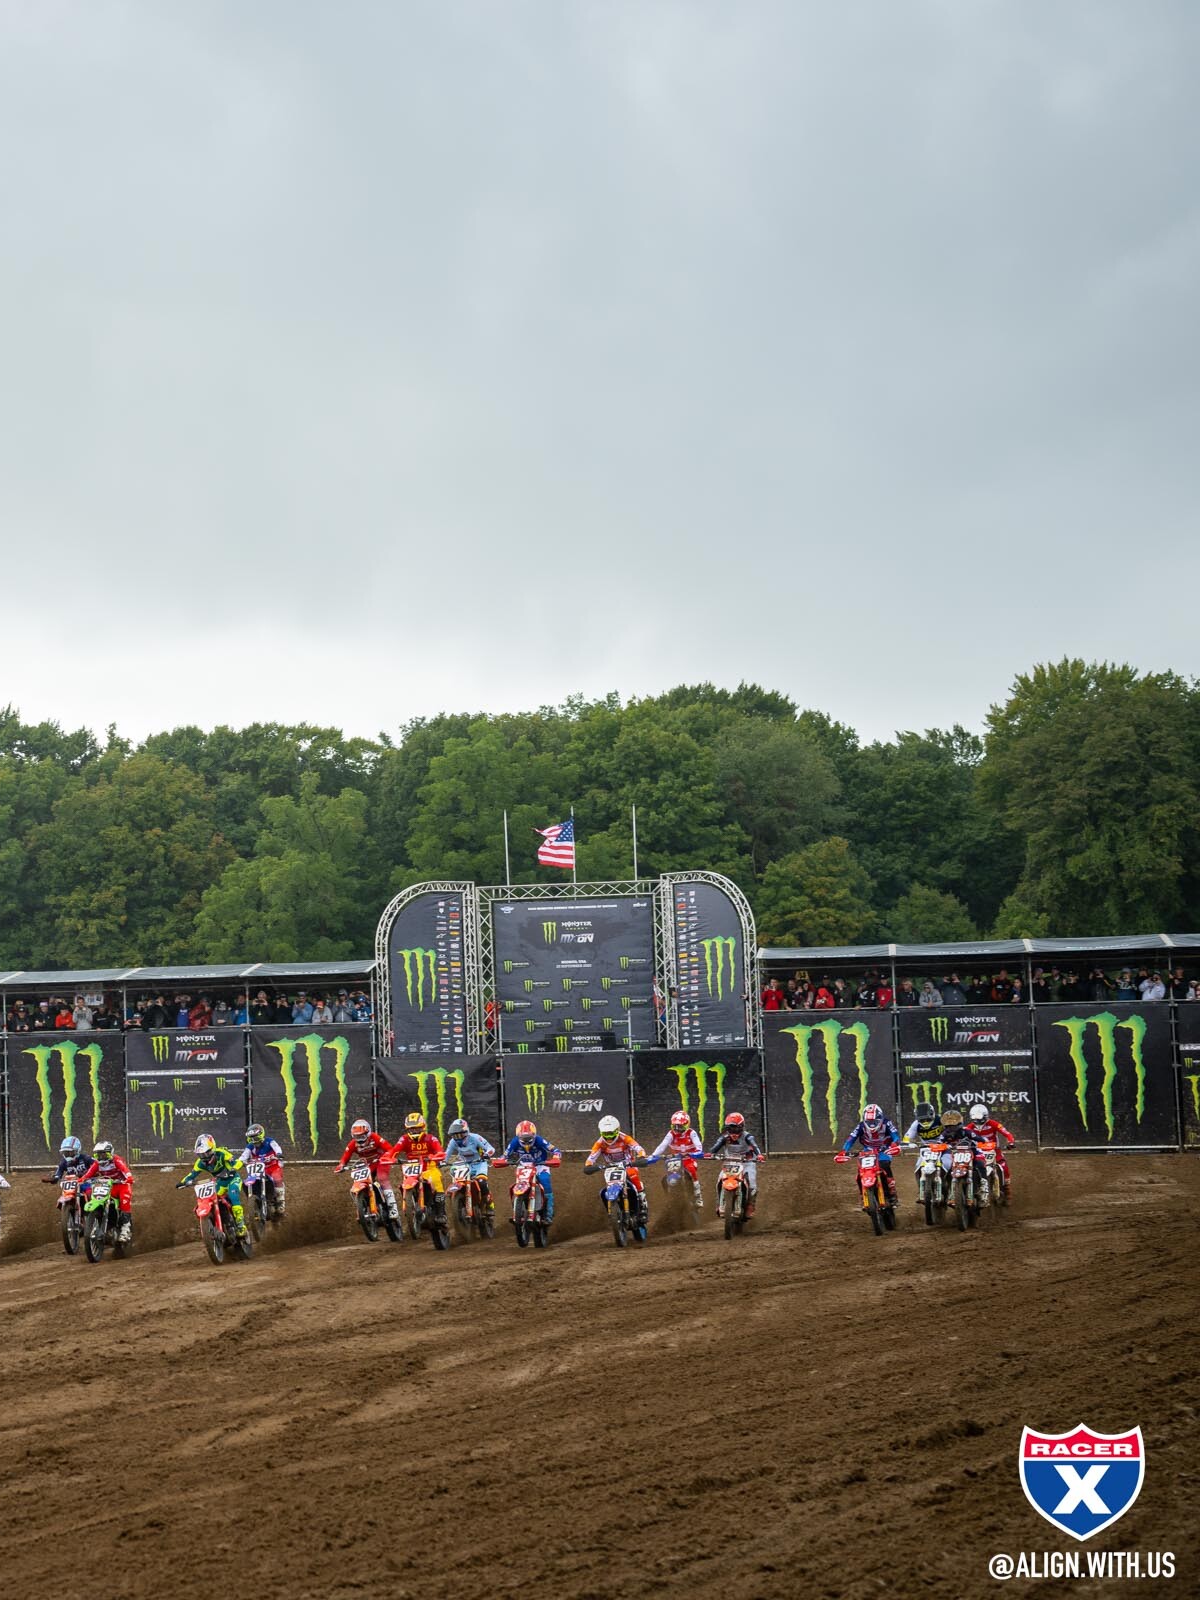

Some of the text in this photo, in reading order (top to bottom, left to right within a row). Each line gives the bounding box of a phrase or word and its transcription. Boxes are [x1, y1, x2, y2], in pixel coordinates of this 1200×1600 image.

[955, 1016, 998, 1024] MONSTER
[176, 1035, 215, 1043] MONSTER
[554, 1082, 601, 1090] MONSTER
[947, 1090, 1031, 1105] MONSTER
[175, 1107, 228, 1116] MONSTER
[861, 1157, 874, 1168] 8
[953, 1152, 971, 1163] 108
[352, 1169, 368, 1181] 69
[405, 1165, 421, 1175] 48
[609, 1171, 623, 1181] 6
